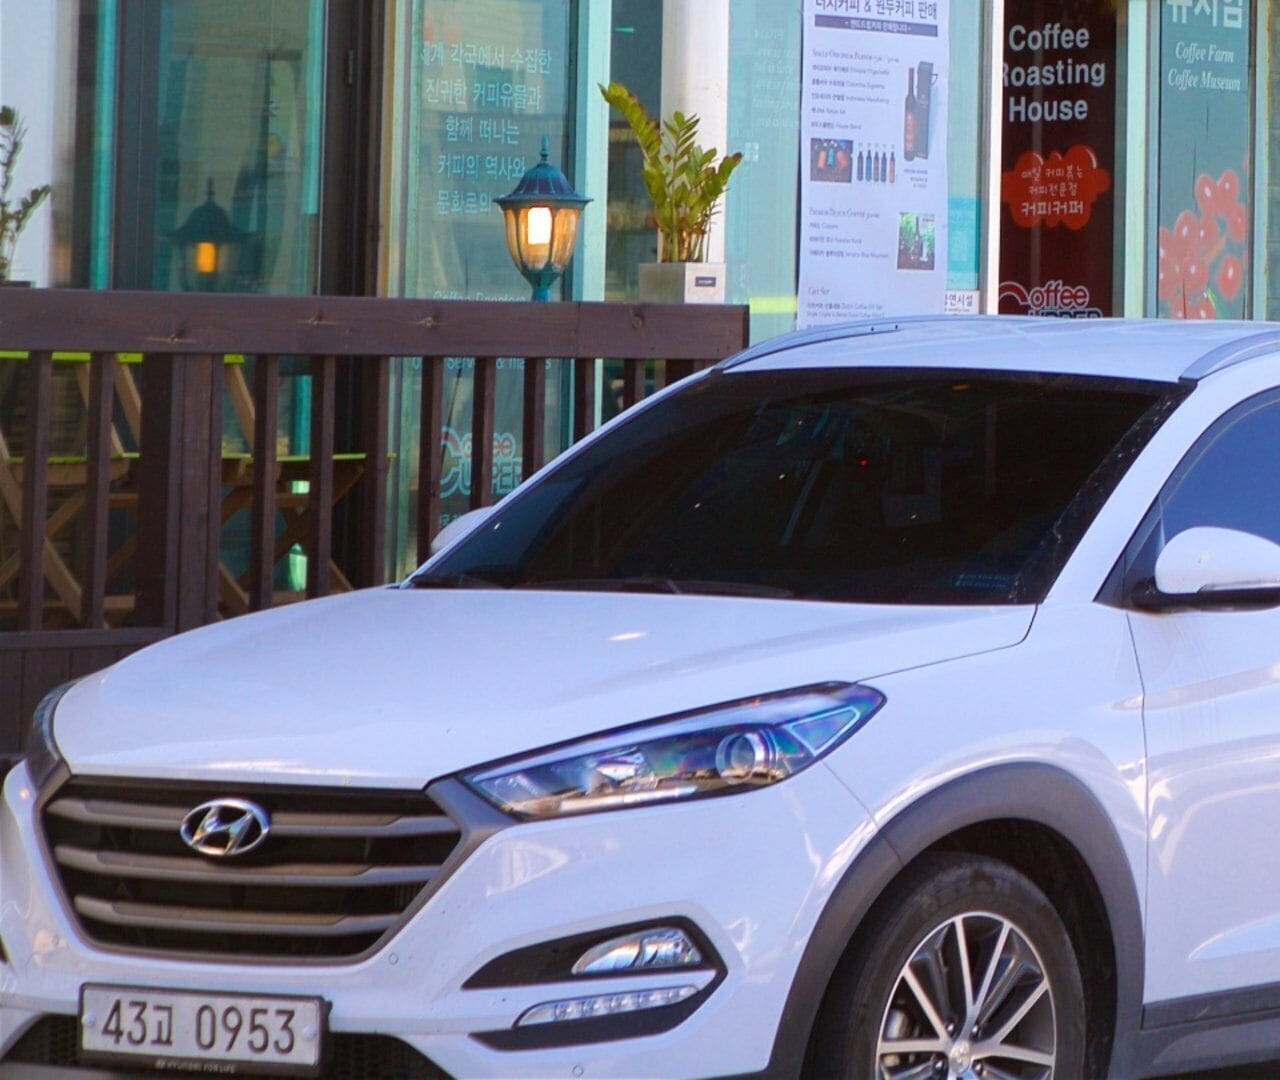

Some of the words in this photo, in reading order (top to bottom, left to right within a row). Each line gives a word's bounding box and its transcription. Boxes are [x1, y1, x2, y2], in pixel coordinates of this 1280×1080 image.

[917, 1, 938, 20] 판매
[1008, 23, 1090, 53] Coffee
[450, 42, 505, 71] 각국에서
[510, 46, 552, 75] 수집한
[1175, 40, 1207, 64] Coffee
[1207, 44, 1235, 63] Farm
[1167, 67, 1200, 91] Coffee
[1200, 70, 1241, 92] Museum
[425, 77, 467, 105] 진귀한
[472, 81, 542, 111] 커피유물과
[1008, 95, 1089, 122] House
[445, 115, 474, 143] 함께
[479, 118, 520, 145] 떠나는
[437, 153, 480, 179] 커피의
[485, 155, 526, 180] 역사와
[1021, 165, 1042, 182] 매일
[436, 189, 493, 215] 문화로의
[1028, 182, 1079, 198] 커피전문점
[1020, 200, 1085, 217] 커피커퍼
[101, 998, 174, 1048] 43고
[195, 1003, 296, 1055] 0953
